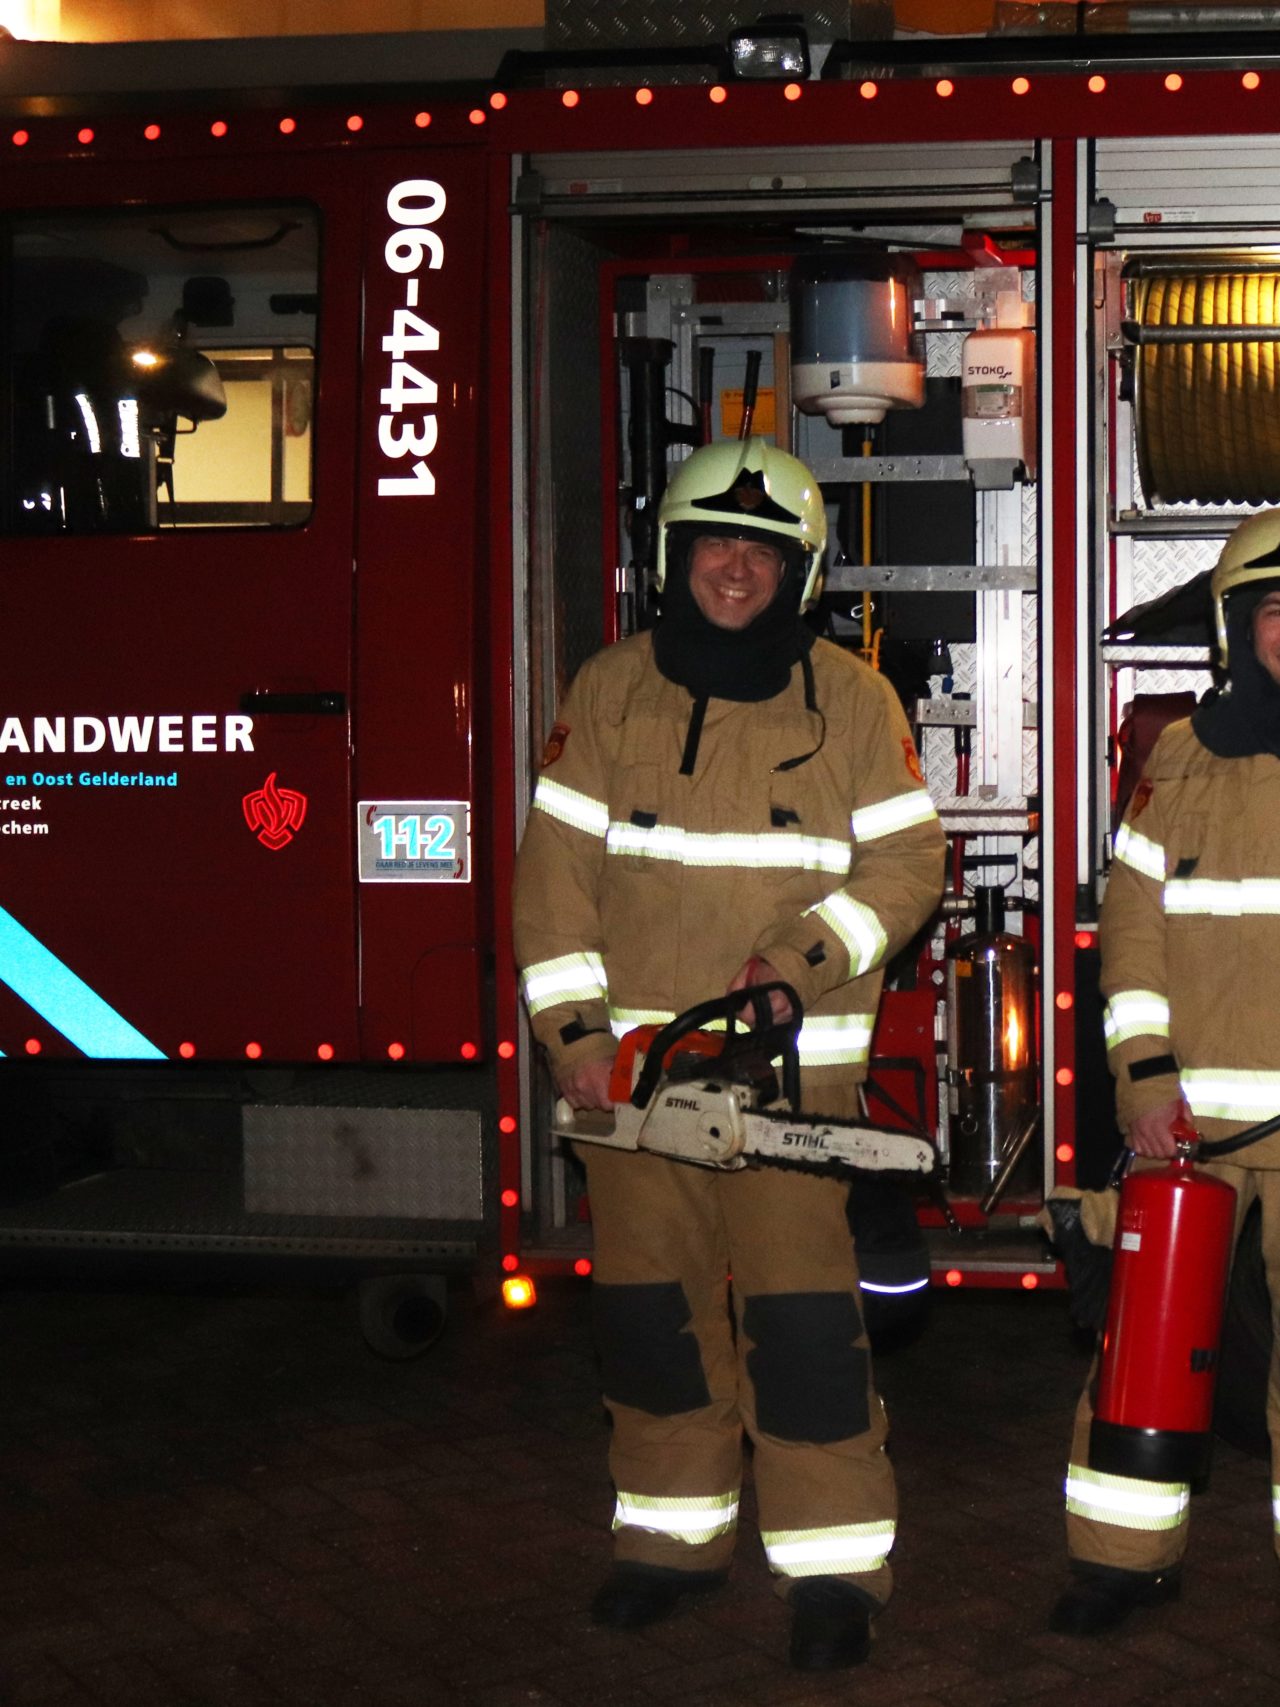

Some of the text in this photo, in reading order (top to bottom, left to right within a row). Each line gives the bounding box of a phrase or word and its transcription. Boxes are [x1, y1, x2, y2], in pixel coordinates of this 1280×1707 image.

[377, 178, 447, 497] 06-4431
[967, 365, 1005, 375] STOKO
[0, 714, 256, 753] ANDWEER
[5, 771, 178, 787] en Oost Gelderland
[0, 795, 42, 810] reek
[0, 820, 49, 835] chem
[665, 1097, 701, 1112] STIHL
[782, 1132, 831, 1150] STIHL
